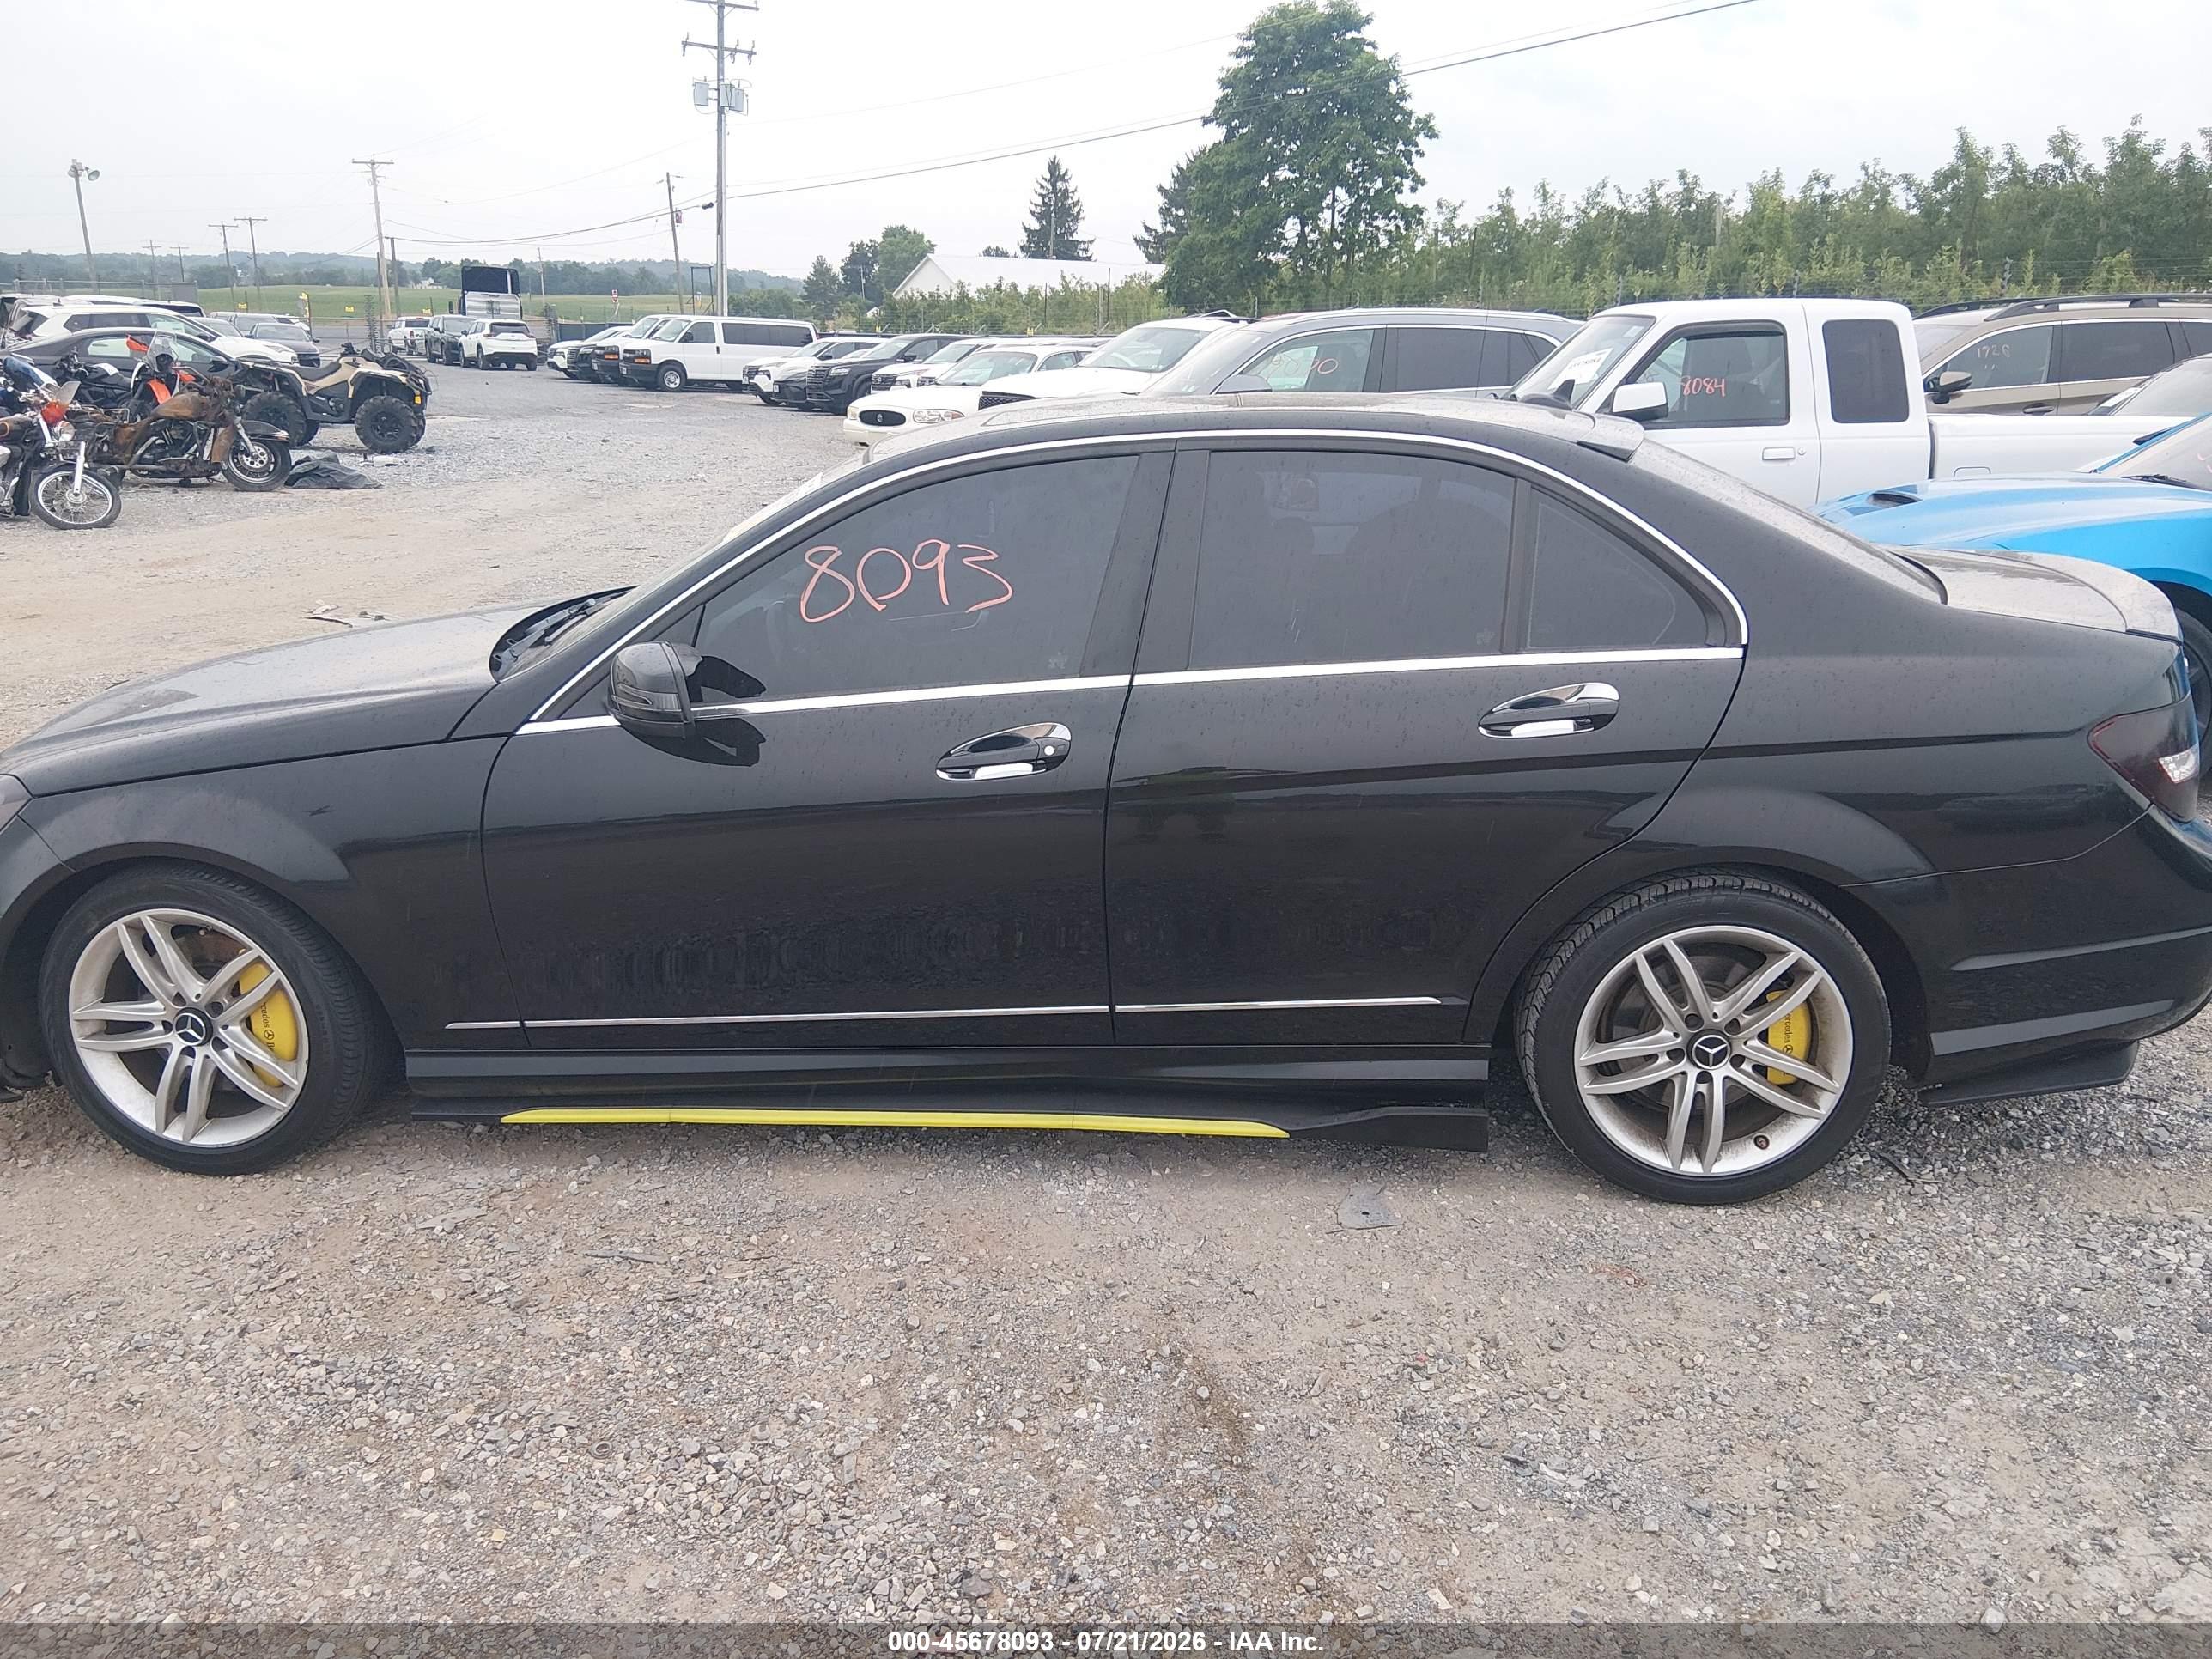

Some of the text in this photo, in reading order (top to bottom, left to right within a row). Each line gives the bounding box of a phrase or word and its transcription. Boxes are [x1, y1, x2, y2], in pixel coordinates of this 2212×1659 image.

[1680, 375, 1726, 398] 8084
[800, 538, 1013, 623] 8093
[1784, 1010, 1794, 1043] ercedes
